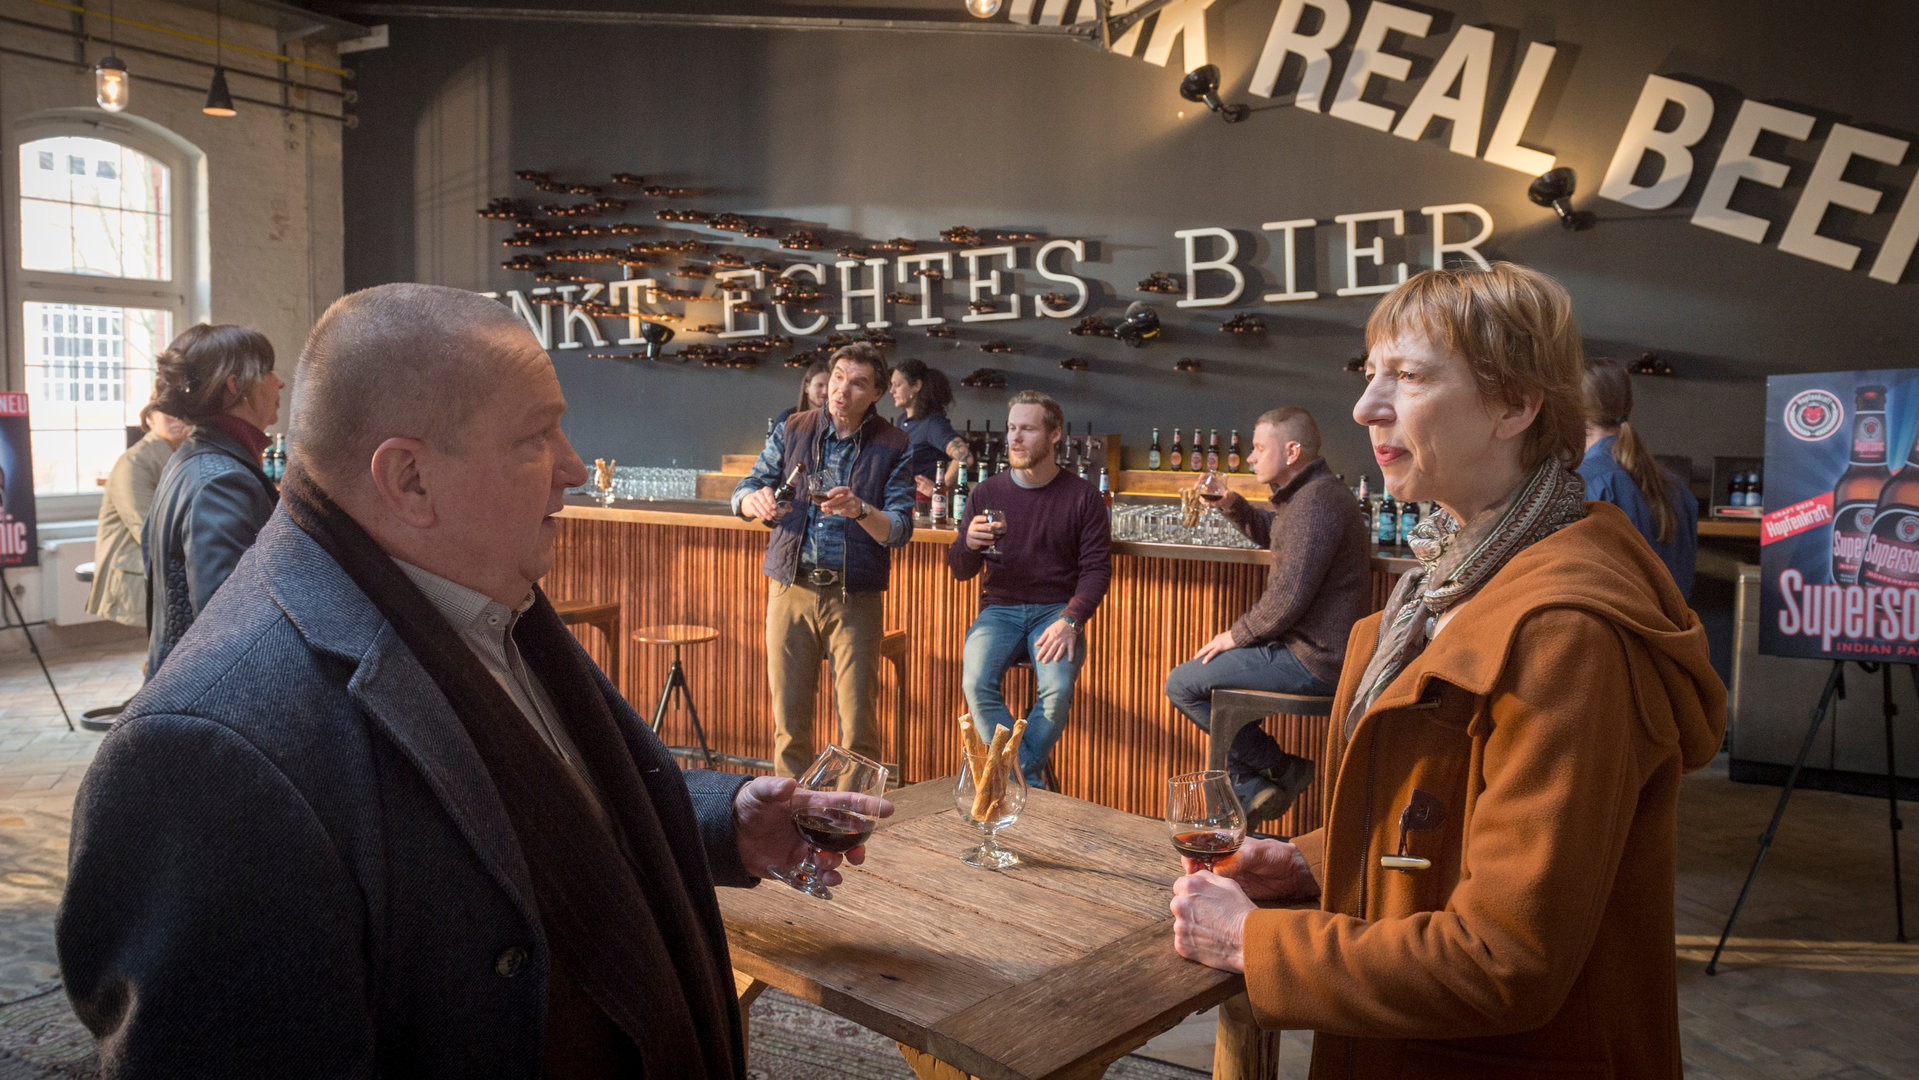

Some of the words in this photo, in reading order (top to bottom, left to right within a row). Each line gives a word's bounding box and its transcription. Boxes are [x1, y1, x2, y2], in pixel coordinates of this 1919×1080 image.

[1248, 0, 1557, 177] REAL
[715, 240, 1089, 338] ECHTES
[1174, 203, 1494, 308] BIER
[1765, 503, 1832, 539] Hopfenkraft
[1778, 568, 1919, 652] Superso
[1836, 642, 1892, 655] INDIAN
